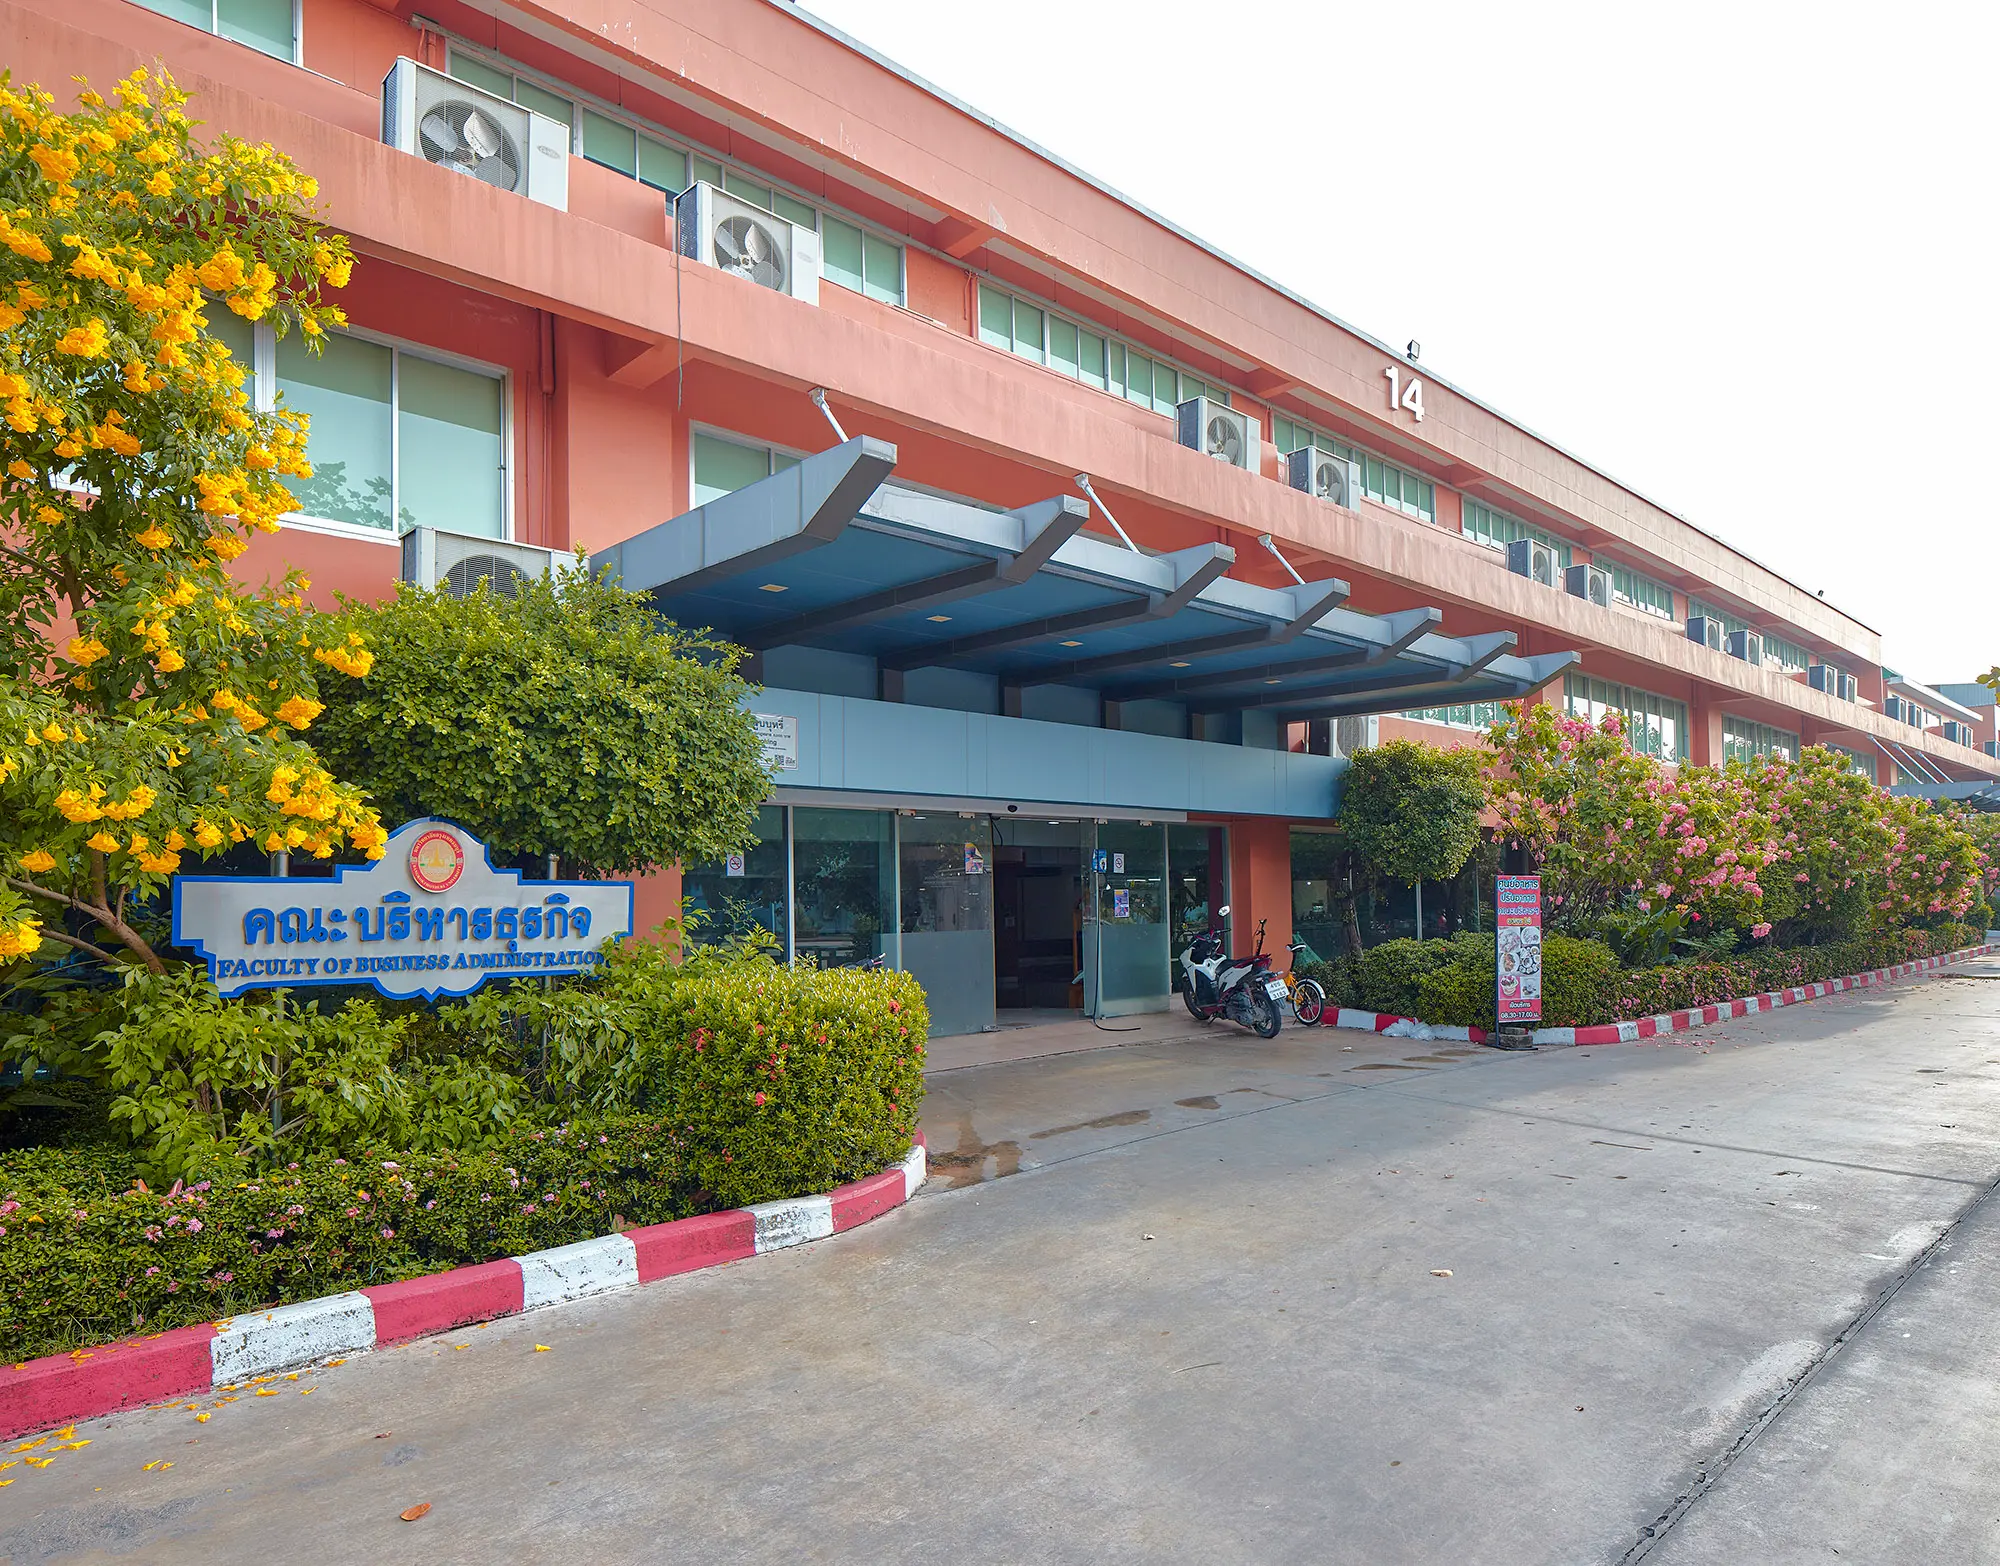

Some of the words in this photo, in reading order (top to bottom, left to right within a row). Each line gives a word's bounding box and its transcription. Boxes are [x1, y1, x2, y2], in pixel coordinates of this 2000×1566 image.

[1384, 365, 1425, 422] 14
[1498, 876, 1539, 892] ศูนย์อาหาร
[244, 891, 593, 952] คณะบริหารธุรกิจ
[217, 958, 320, 979] FACULTY
[323, 957, 353, 975] OF
[355, 954, 450, 973] BUSINESS
[452, 950, 605, 970] ADMINISTRATION
